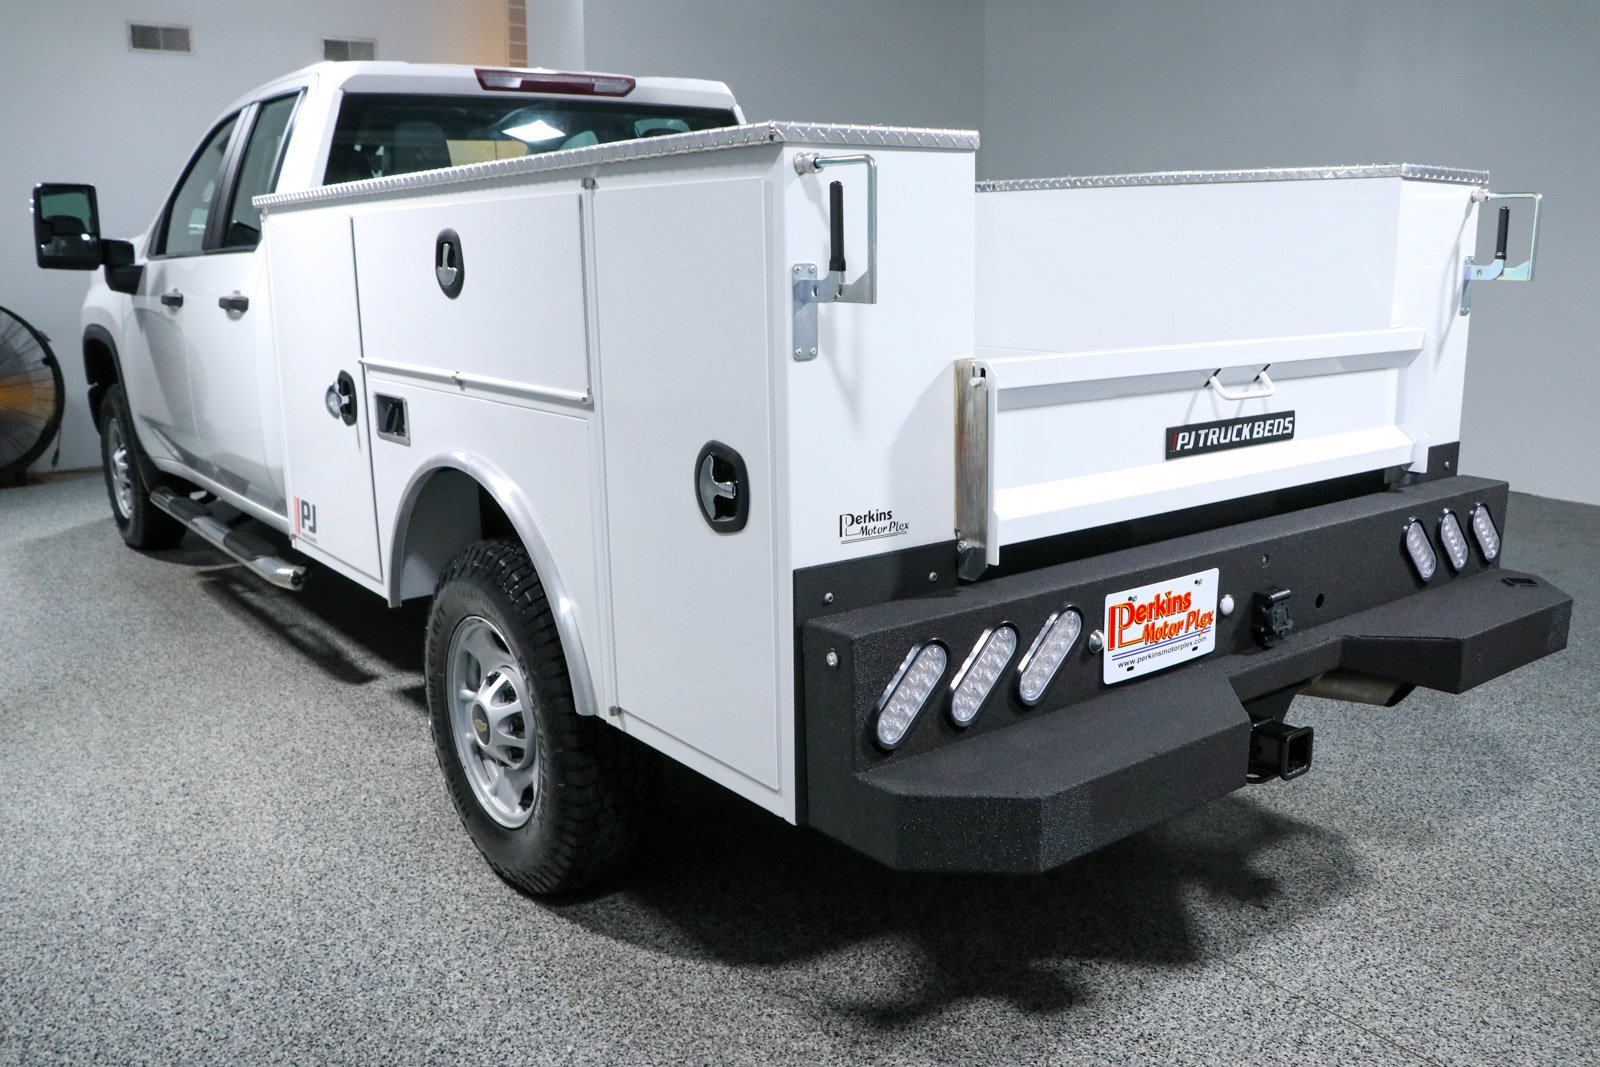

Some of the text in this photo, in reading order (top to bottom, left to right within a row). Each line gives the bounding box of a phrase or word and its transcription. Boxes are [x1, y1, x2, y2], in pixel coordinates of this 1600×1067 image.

[1175, 416, 1294, 451] PJ TRUCK BEDS
[300, 499, 317, 534] PJ
[839, 509, 893, 538] Perkins
[859, 521, 910, 536] Motor Plex
[1108, 590, 1192, 651] Perkins
[1142, 608, 1214, 645] Motor Plex
[1117, 636, 1207, 669] www.perkinsmotorplex.com
